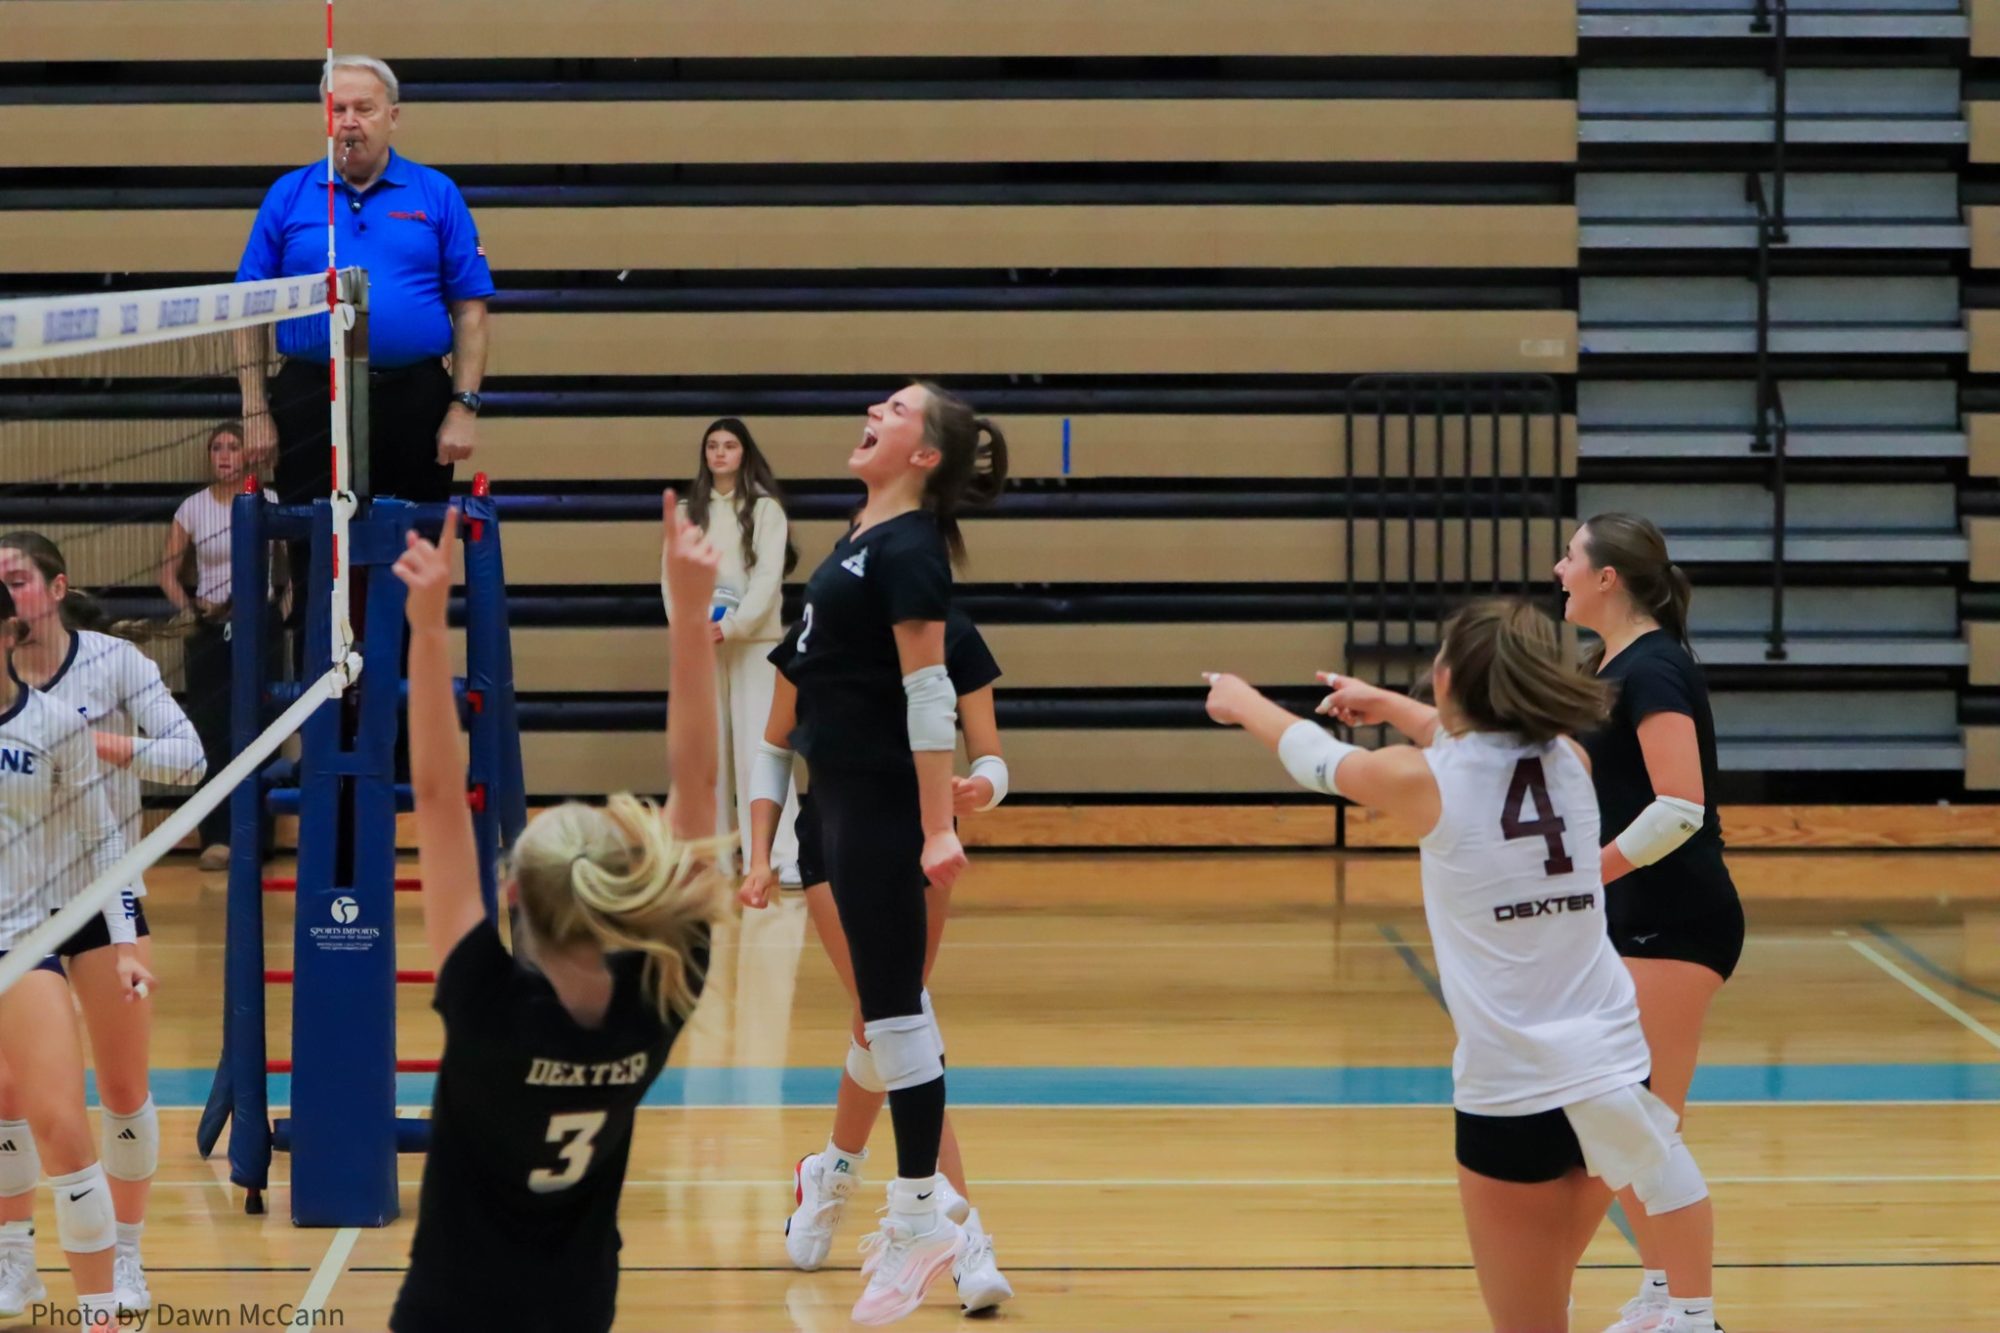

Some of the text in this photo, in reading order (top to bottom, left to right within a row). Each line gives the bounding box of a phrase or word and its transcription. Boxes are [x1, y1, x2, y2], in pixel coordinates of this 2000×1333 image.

[796, 602, 814, 653] 2
[1501, 756, 1573, 876] 4
[1494, 894, 1595, 921] DEXTER
[310, 927, 341, 937] SPORTS
[343, 927, 380, 937] IMPORTS
[525, 1052, 647, 1086] DEXTER
[528, 1111, 607, 1193] 3
